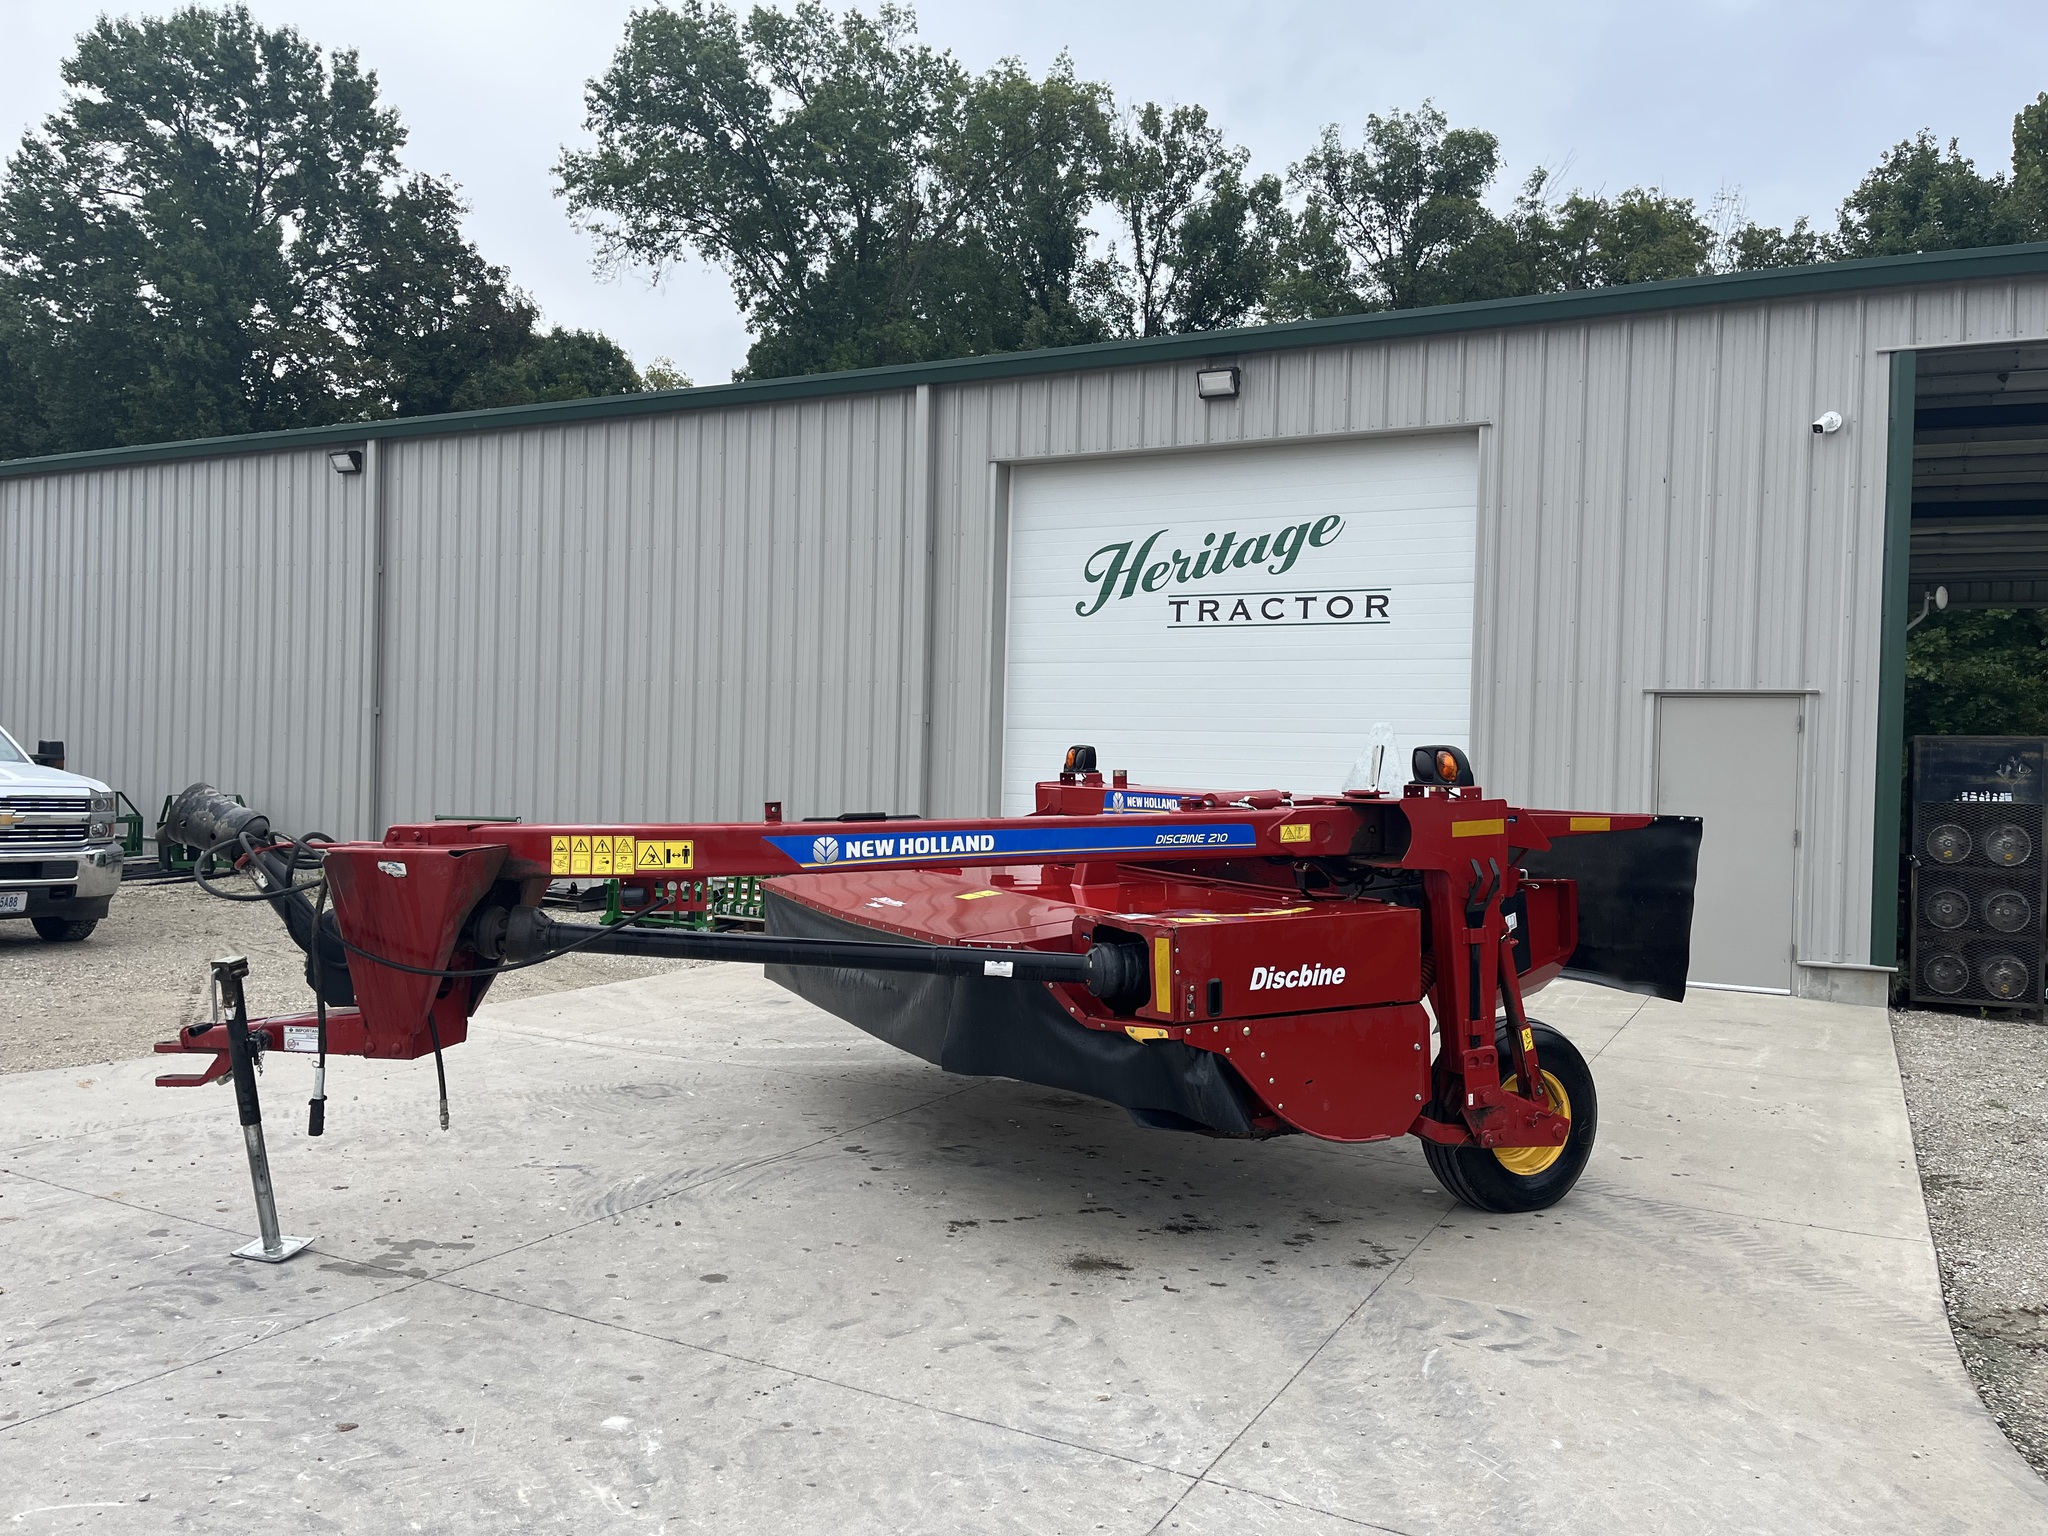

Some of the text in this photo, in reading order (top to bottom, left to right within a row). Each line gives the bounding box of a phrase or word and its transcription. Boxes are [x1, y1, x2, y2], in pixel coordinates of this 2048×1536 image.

[1075, 514, 1346, 617] Heritage
[1168, 595, 1389, 622] TRACTOR
[1127, 796, 1178, 810] NEW HOLLAND
[846, 835, 994, 859] NEW HOLLAND
[1155, 833, 1228, 845] DISCBINE 210
[1249, 963, 1346, 991] Discbine
